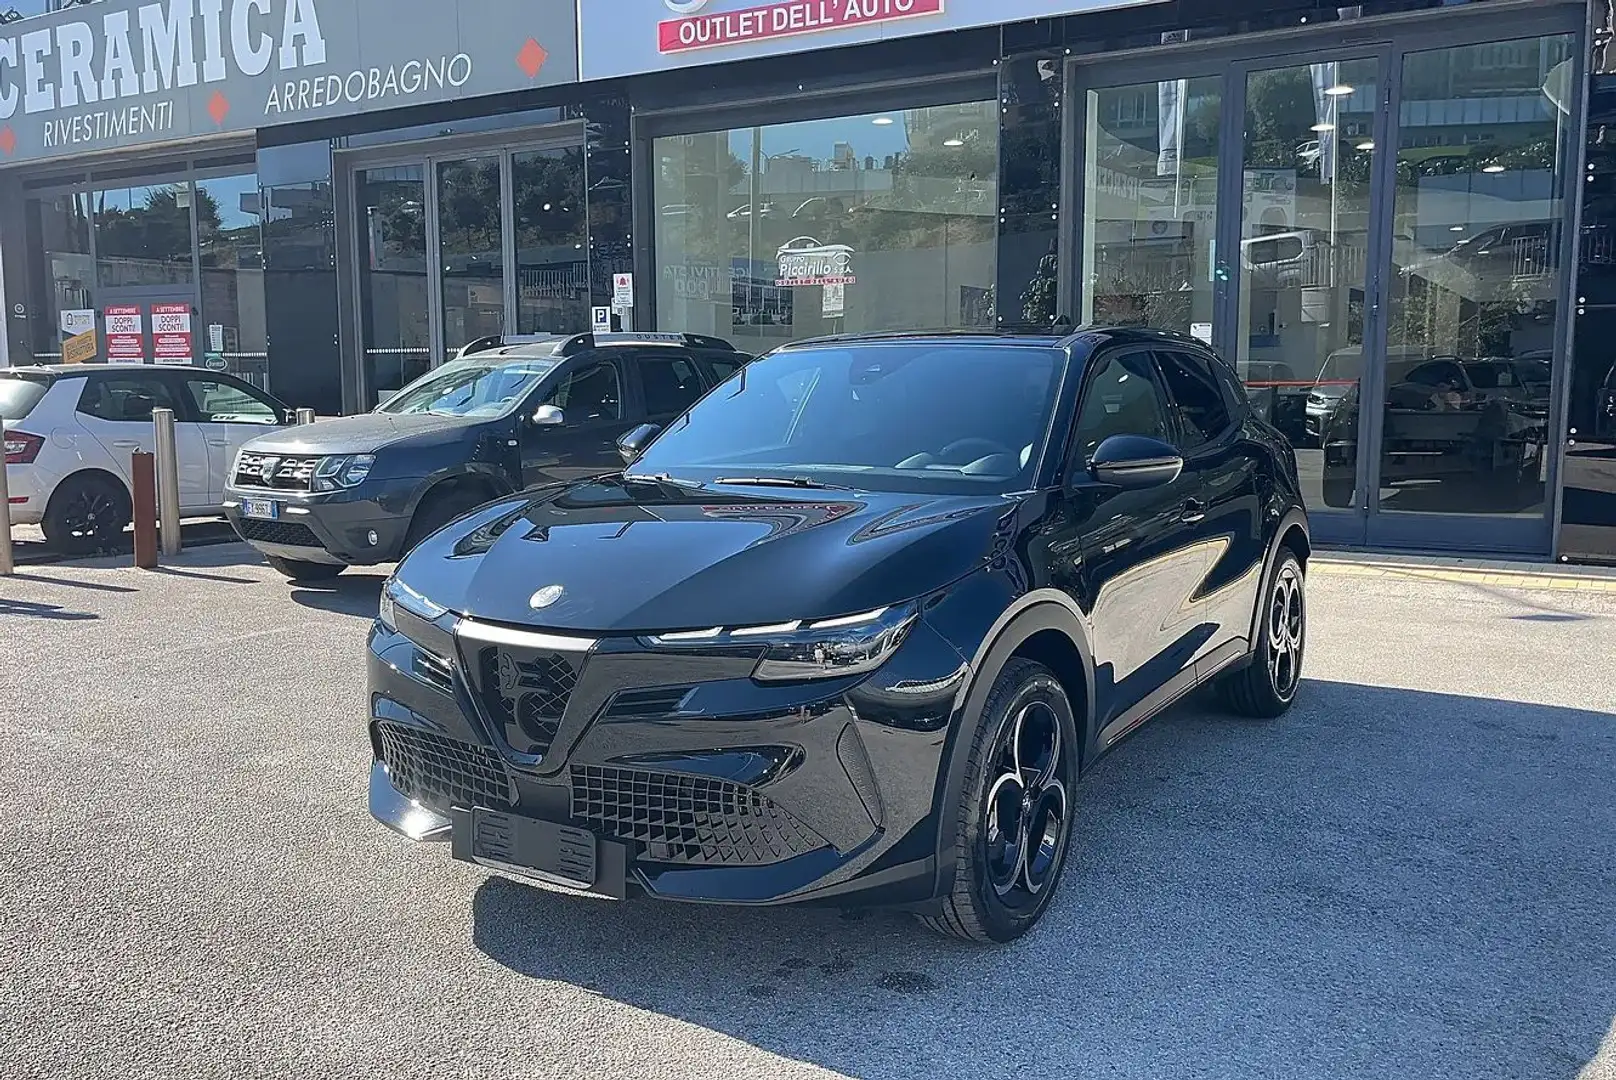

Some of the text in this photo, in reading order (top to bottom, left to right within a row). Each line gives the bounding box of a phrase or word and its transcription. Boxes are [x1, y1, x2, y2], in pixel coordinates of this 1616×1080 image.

[679, 9, 768, 45] OUTLET
[0, 0, 327, 119] CERAMICA
[264, 53, 472, 114] ARREDOBAGNO
[43, 101, 173, 147] RIVESTIMENTI
[161, 315, 181, 323] DOPPI
[597, 309, 605, 322] P
[637, 333, 684, 341] DUSTER
